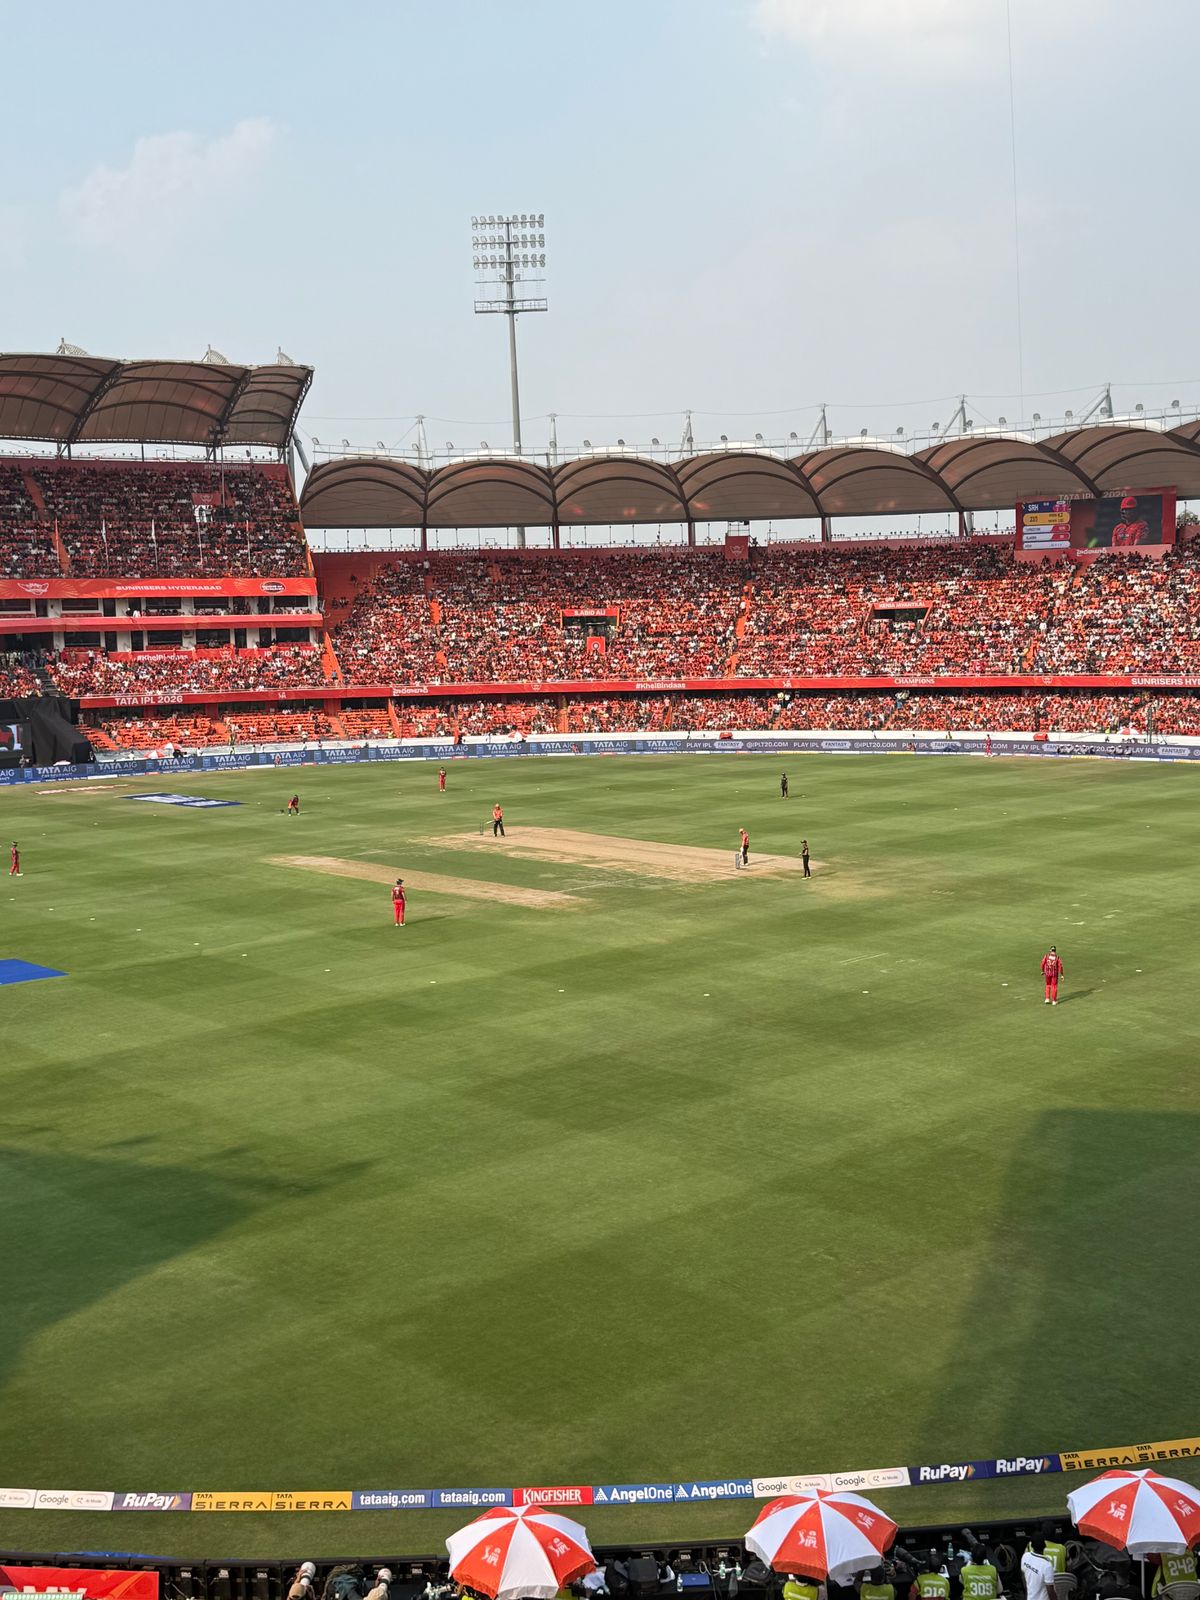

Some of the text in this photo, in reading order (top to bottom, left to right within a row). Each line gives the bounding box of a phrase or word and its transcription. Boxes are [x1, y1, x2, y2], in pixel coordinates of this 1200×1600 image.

[924, 536, 972, 545] HYDERABAD
[115, 696, 183, 705] TATA IPL 2026
[180, 757, 195, 765] AIG
[292, 751, 306, 759] AIG
[36, 765, 77, 775] TATA AIG
[98, 763, 122, 771] TATA
[123, 761, 138, 769] AIG
[996, 1457, 1044, 1474] RuPay
[1065, 1456, 1133, 1470] SIERRA
[919, 1464, 969, 1481] RuPay
[756, 1482, 788, 1493] Google
[834, 1476, 865, 1487] Google
[610, 1487, 673, 1503] AngelOne
[690, 1482, 752, 1498] AngelOne
[39, 1494, 69, 1504] Google
[122, 1492, 174, 1510] RuPay
[360, 1493, 425, 1507] tataaig.com
[440, 1491, 505, 1505] tataaig.com
[522, 1489, 582, 1504] KINGFISHER
[195, 1501, 267, 1510] SIERRA
[275, 1501, 347, 1510] SIERRA
[1023, 1562, 1039, 1575] POLICE
[1168, 1556, 1196, 1576] 242
